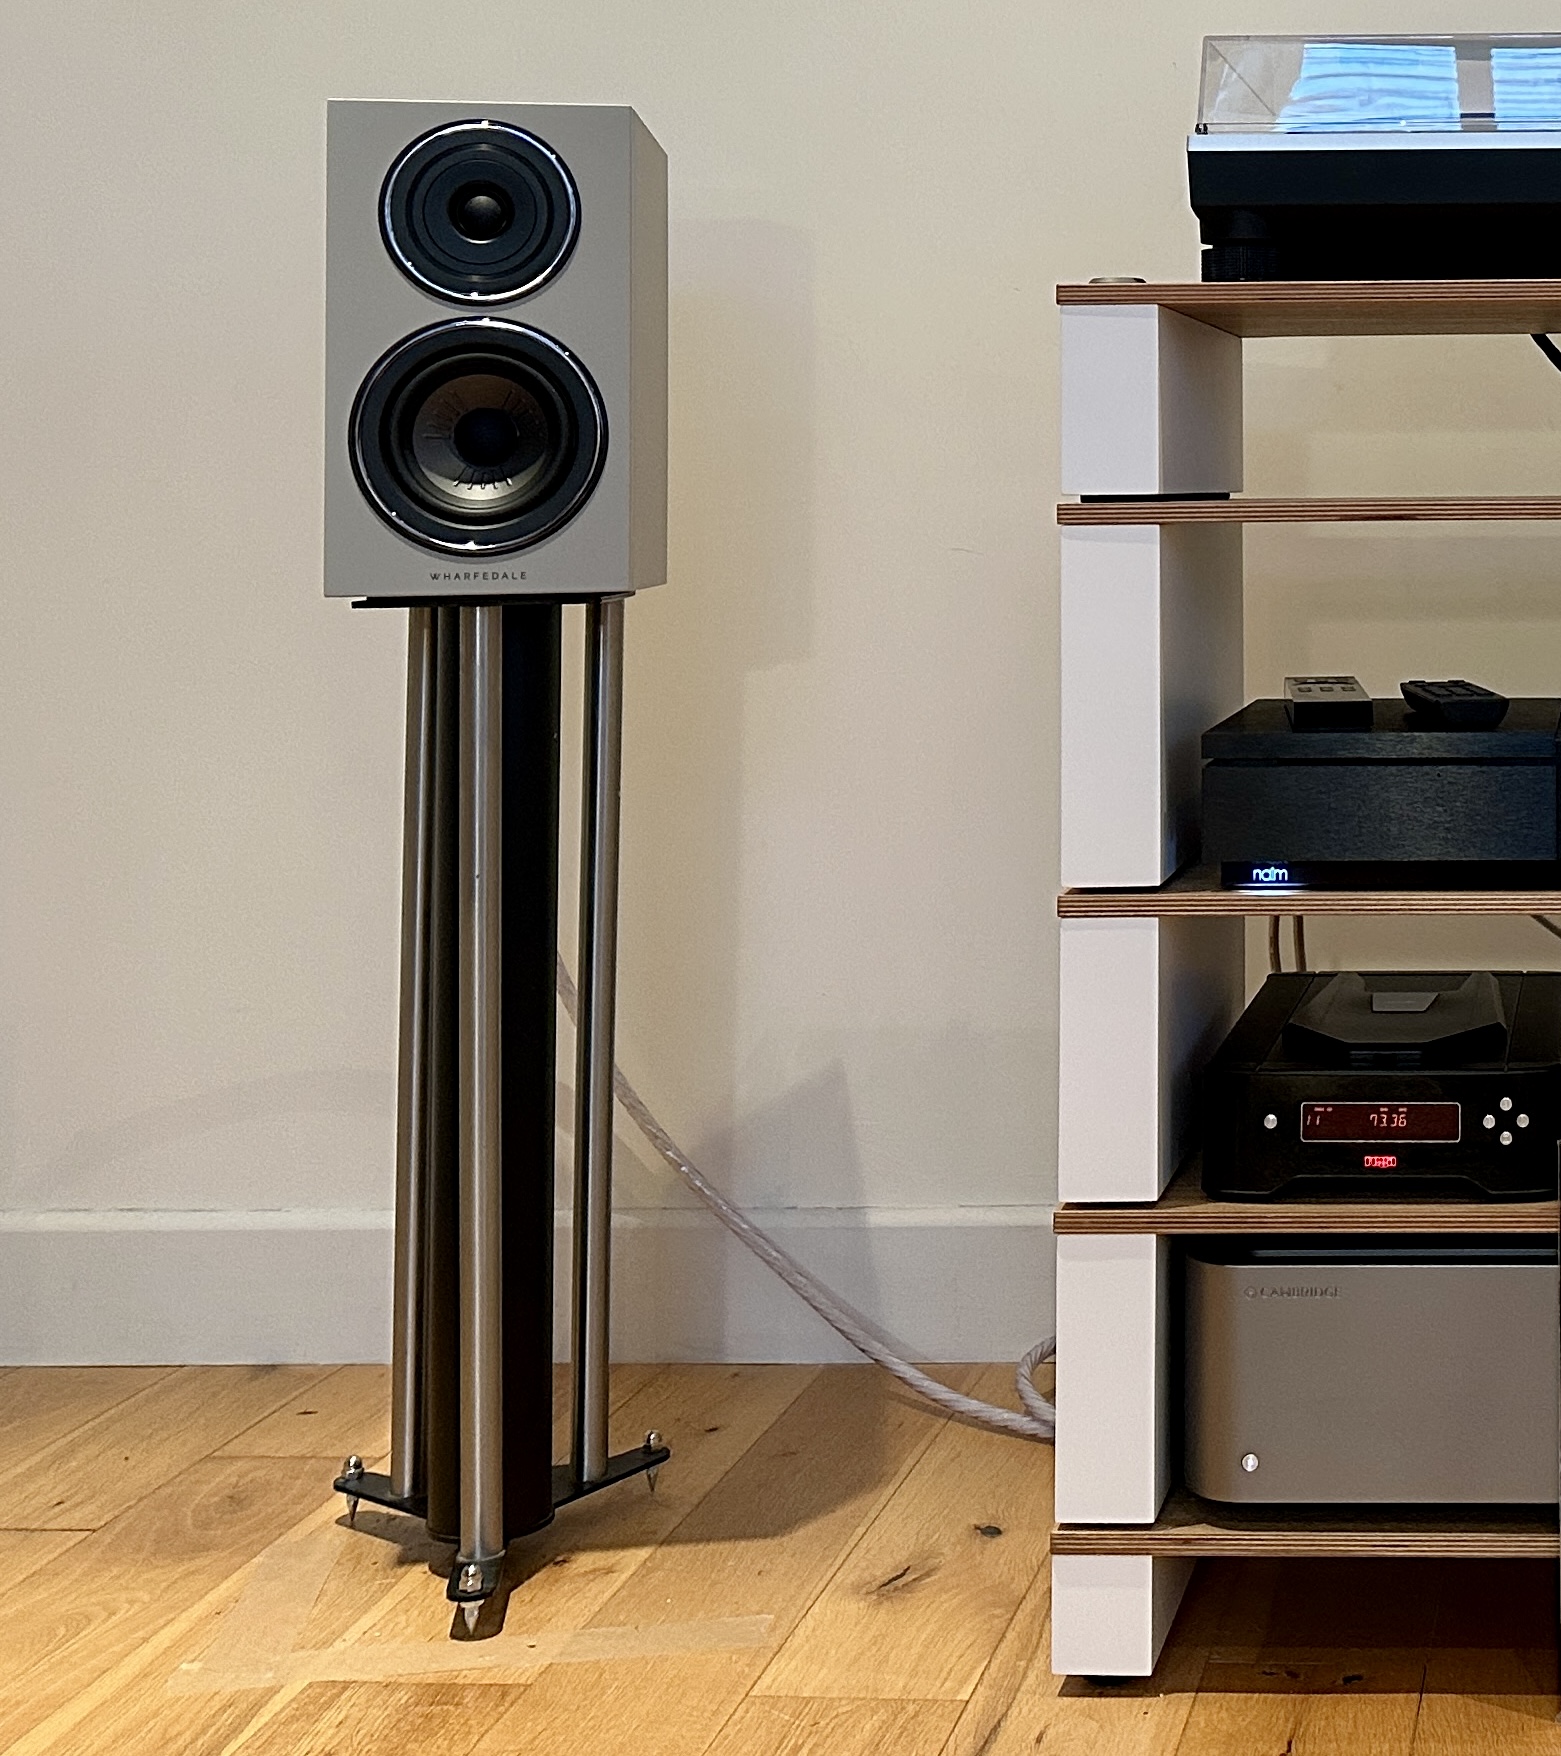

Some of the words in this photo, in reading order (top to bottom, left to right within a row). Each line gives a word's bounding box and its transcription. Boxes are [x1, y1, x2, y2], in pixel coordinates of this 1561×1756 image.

[430, 571, 527, 581] WHARFEDALE
[1252, 866, 1289, 881] naim
[1260, 1286, 1341, 1298] CAMBRIDGE
